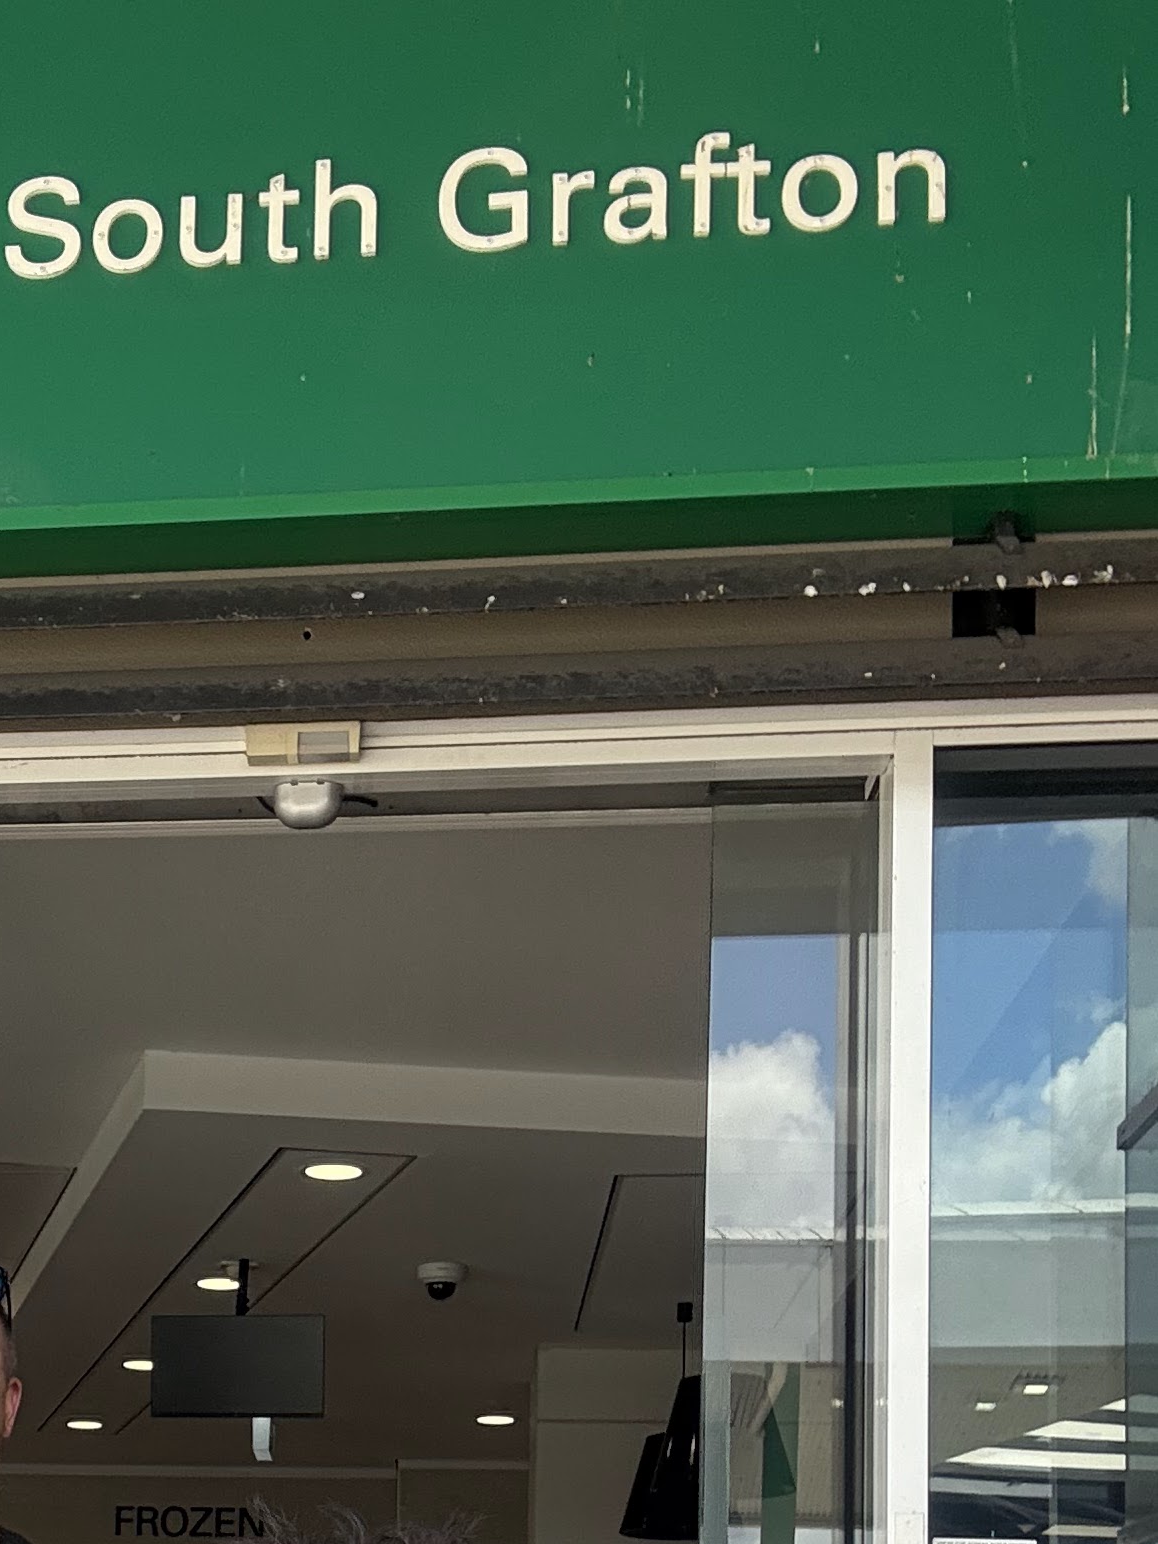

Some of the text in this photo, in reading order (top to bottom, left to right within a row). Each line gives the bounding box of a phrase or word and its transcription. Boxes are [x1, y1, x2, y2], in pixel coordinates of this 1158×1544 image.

[4, 158, 379, 279] South
[438, 132, 948, 254] Grafton
[114, 1505, 265, 1537] FROZEN
